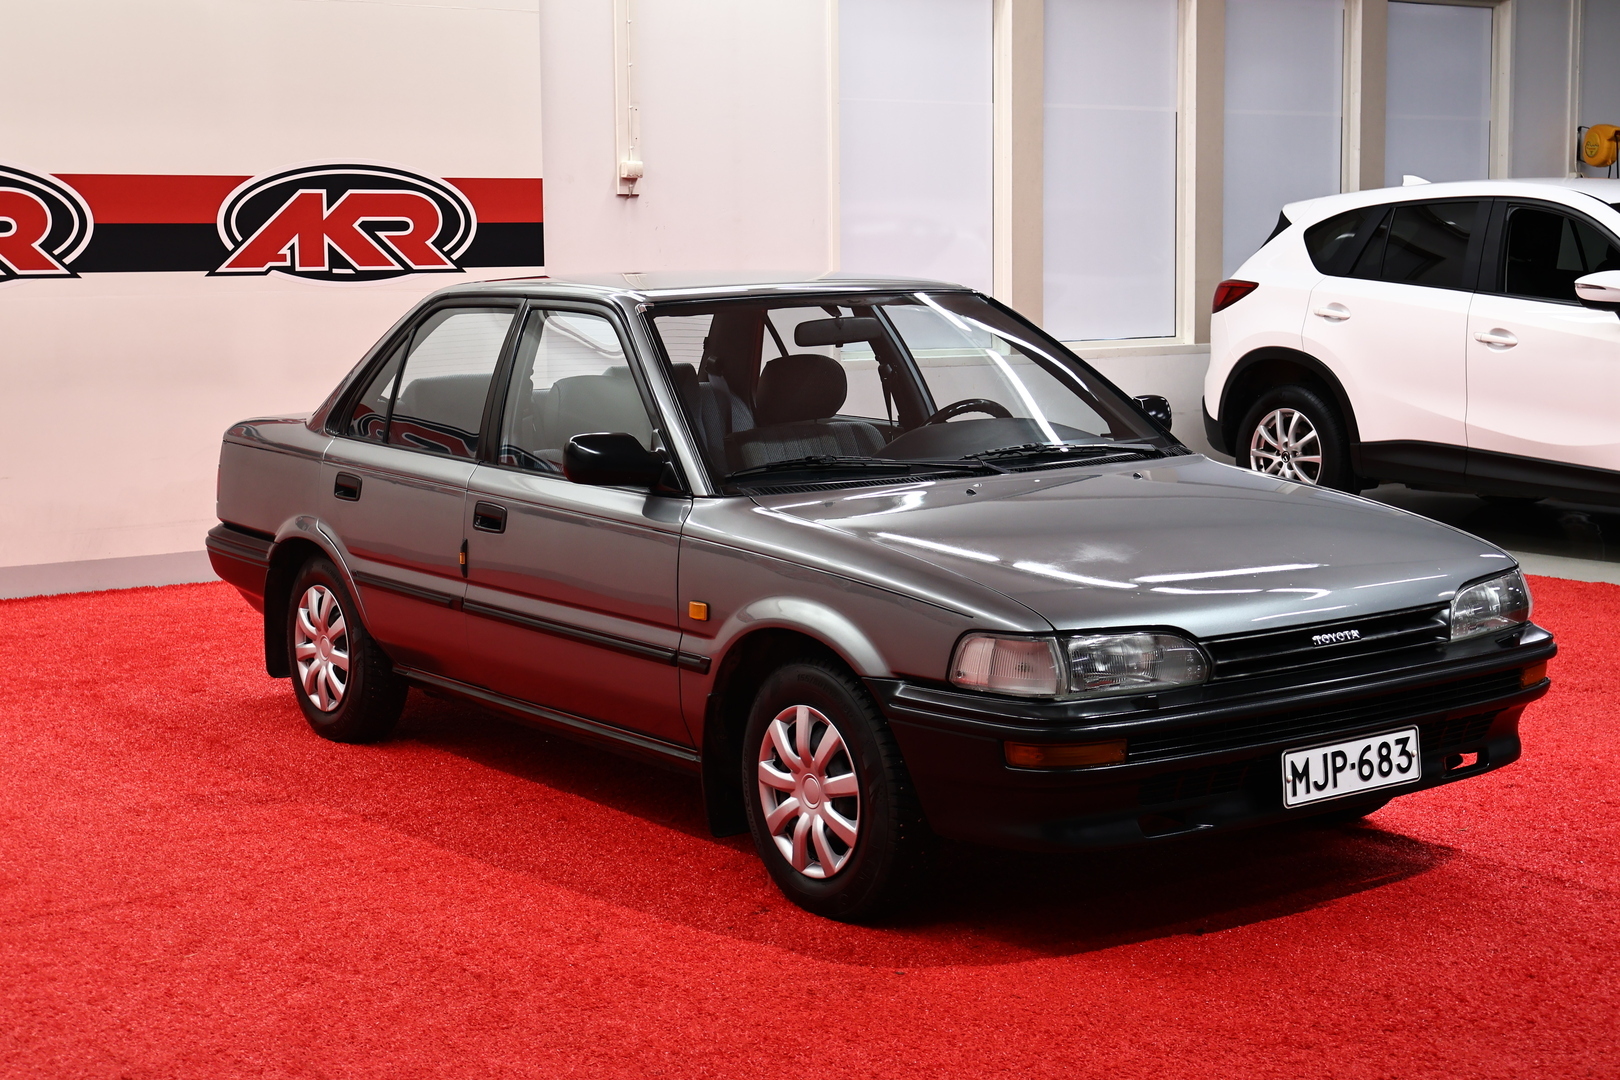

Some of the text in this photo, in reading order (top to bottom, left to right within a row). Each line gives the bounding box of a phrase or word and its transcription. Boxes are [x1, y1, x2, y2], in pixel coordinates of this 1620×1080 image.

[214, 188, 459, 273] AKR
[1312, 629, 1361, 645] TOYOTA
[1290, 736, 1413, 797] MJP-683
